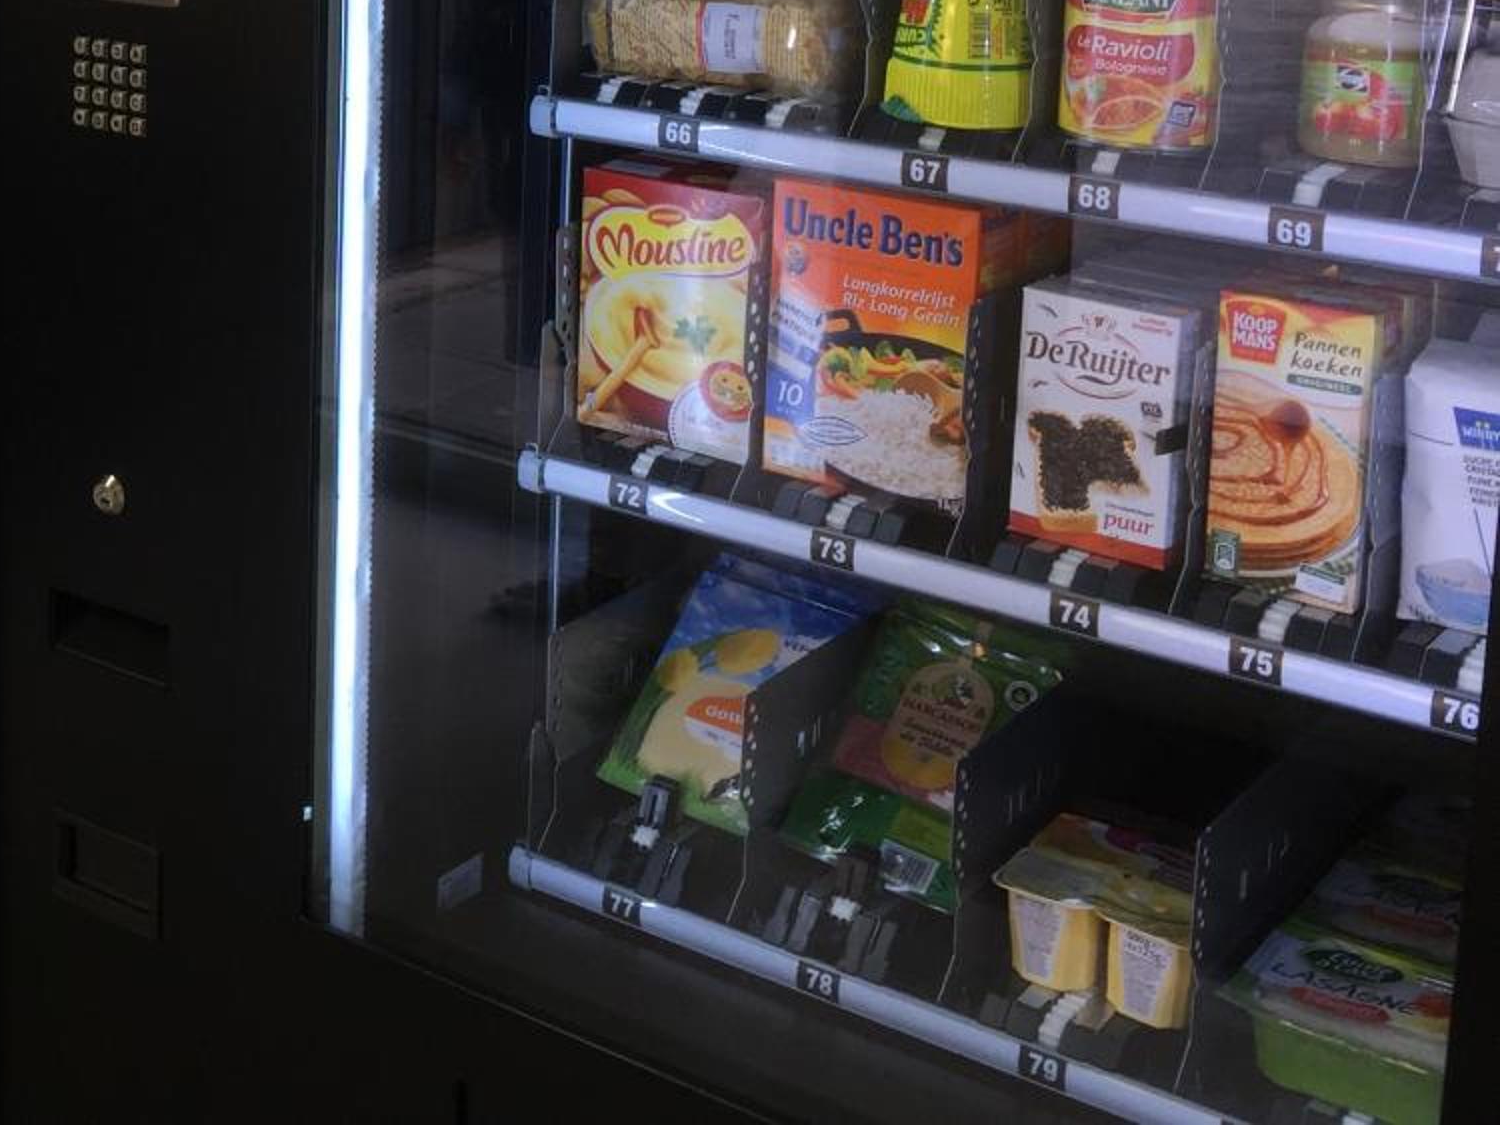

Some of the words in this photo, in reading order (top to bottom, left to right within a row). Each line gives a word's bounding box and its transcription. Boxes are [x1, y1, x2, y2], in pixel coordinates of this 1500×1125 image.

[1091, 34, 1173, 61] Ravioli
[664, 121, 692, 145] 66
[909, 158, 939, 183] 67
[1077, 186, 1110, 210] 68
[783, 196, 874, 251] Uncle
[879, 213, 965, 268] Ben's
[1275, 219, 1312, 247] 69
[595, 223, 746, 270] Mousline
[842, 291, 865, 308] Riz
[869, 298, 908, 321] Long
[912, 305, 960, 329] Grain
[1232, 310, 1278, 332] KOOP
[1231, 327, 1277, 350] MANS
[1293, 329, 1362, 360] Pannen
[1289, 349, 1363, 378] koeken
[777, 379, 805, 406] 10
[615, 482, 642, 506] 72
[1102, 511, 1155, 536] puur
[818, 540, 847, 565] 73
[1058, 601, 1090, 628] 74
[1239, 646, 1274, 675] 75
[1442, 699, 1479, 729] 76
[610, 894, 636, 917] 77
[804, 969, 834, 995] 78
[1028, 1052, 1059, 1083] 79
